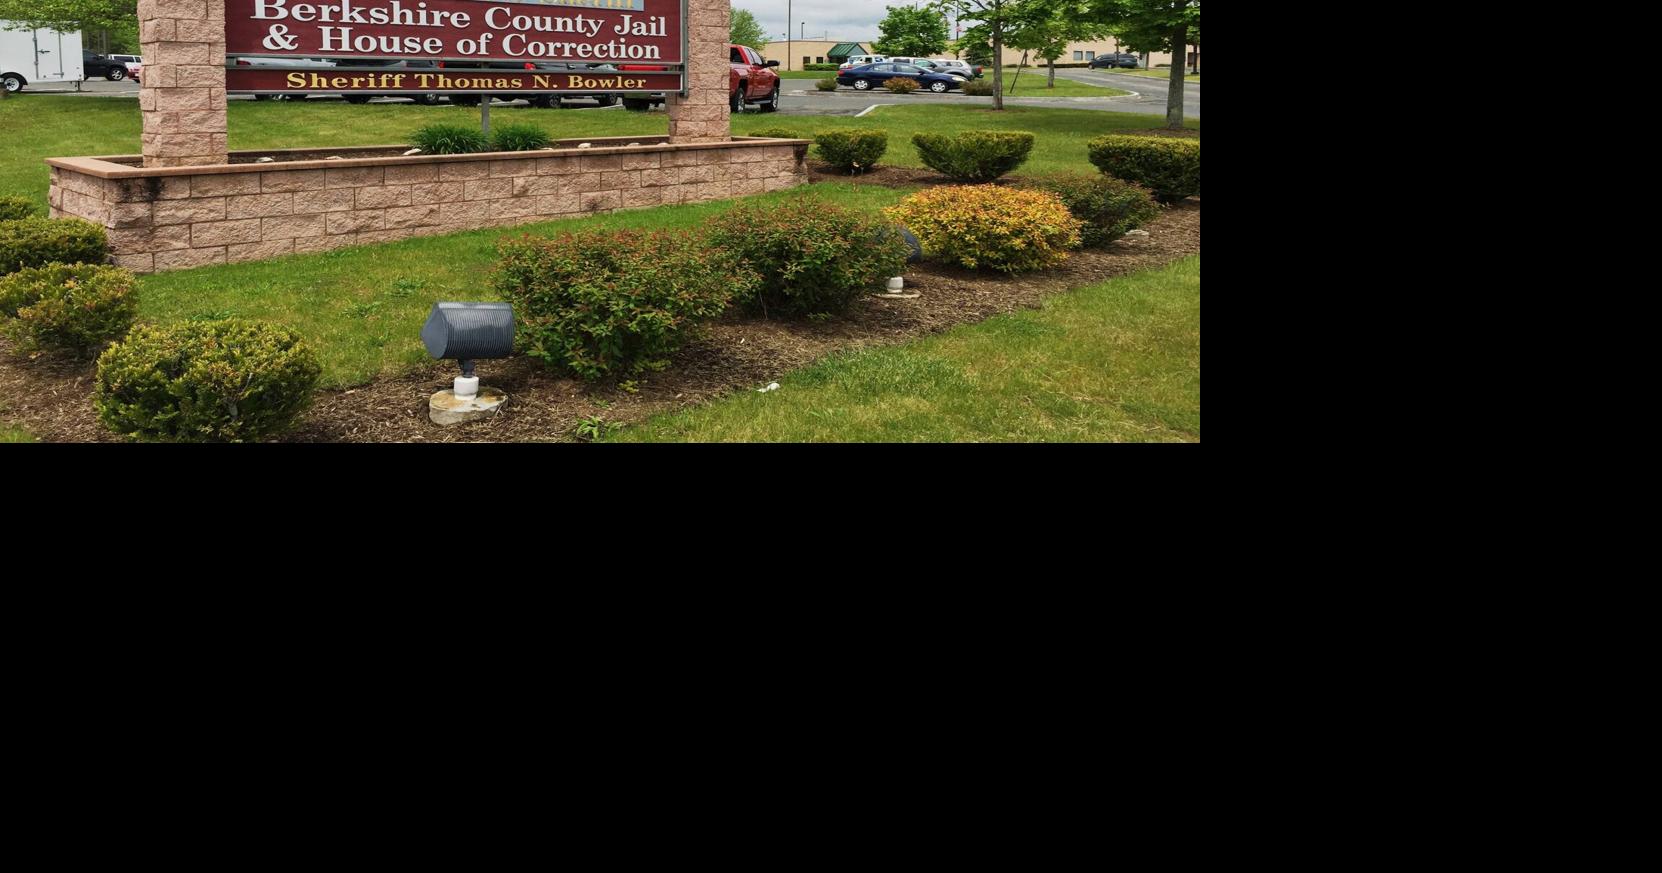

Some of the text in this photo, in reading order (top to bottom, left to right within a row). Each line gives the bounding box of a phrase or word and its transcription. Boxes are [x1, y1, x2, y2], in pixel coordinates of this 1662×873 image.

[250, 0, 471, 28] Berkshire
[484, 6, 605, 38] County
[613, 14, 668, 37] Jail
[262, 23, 662, 59] & House of Correction
[286, 72, 647, 89] Sheriff Thomas N. Bowler
